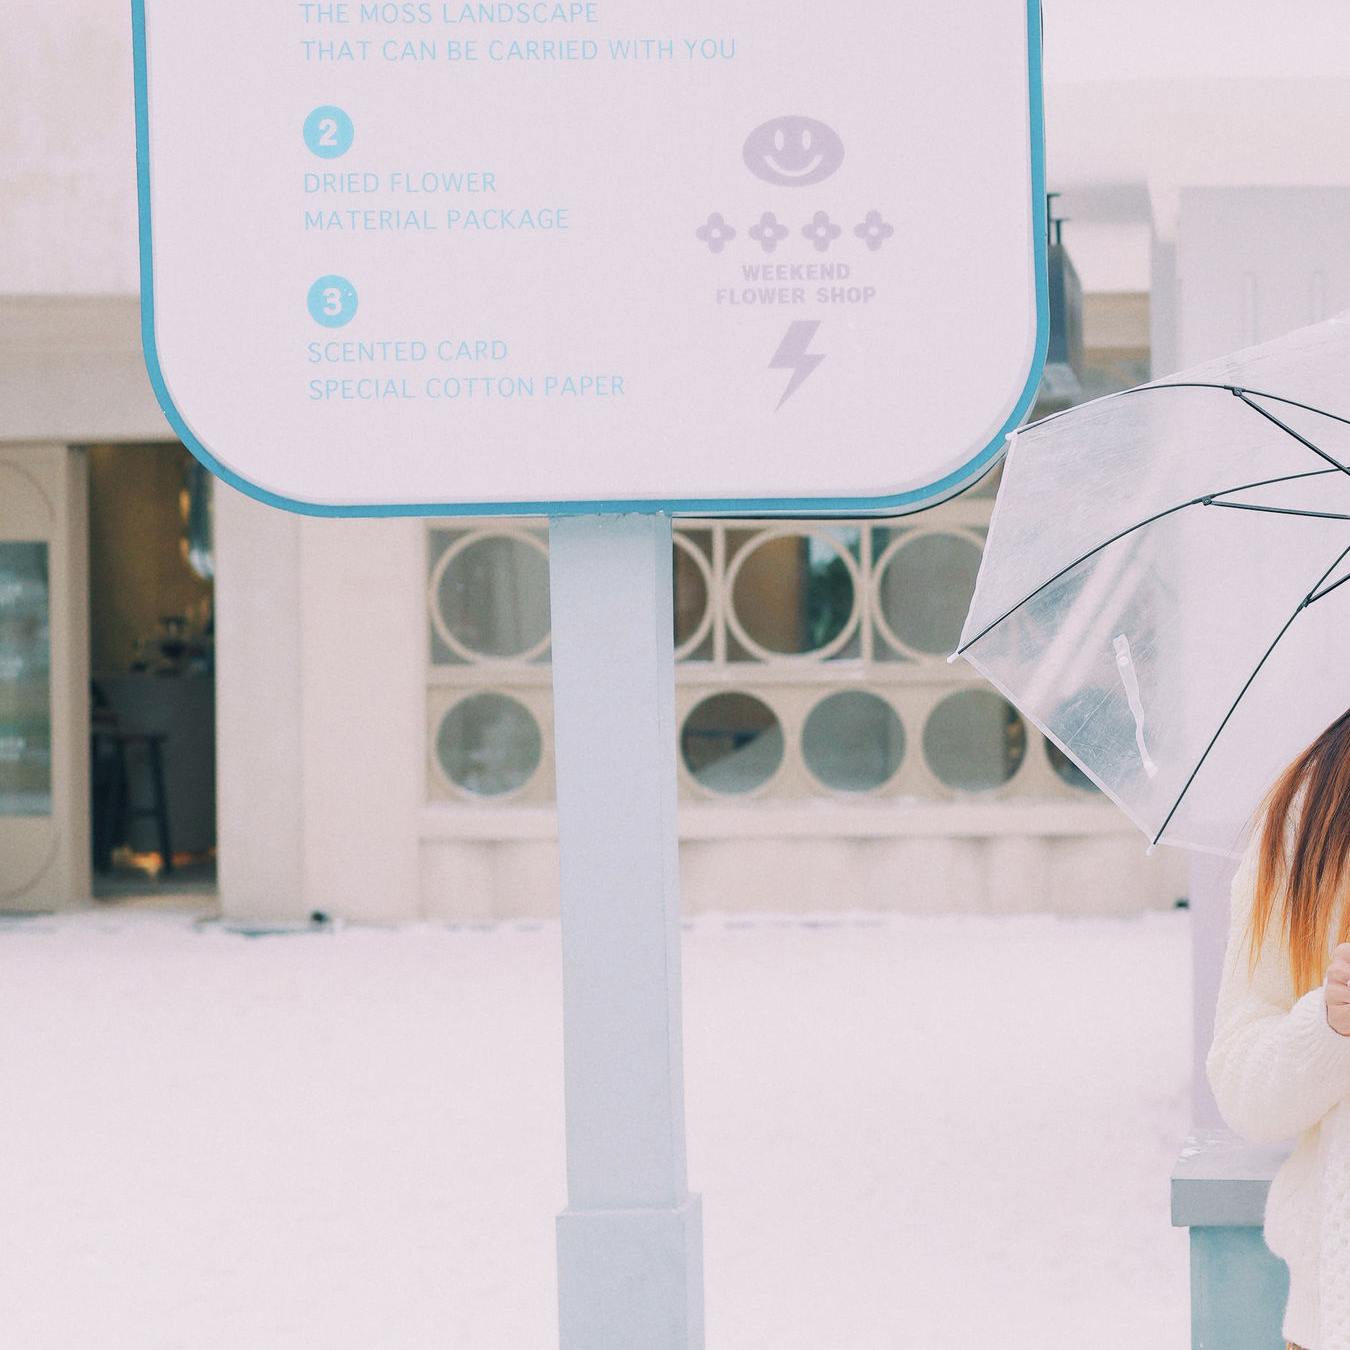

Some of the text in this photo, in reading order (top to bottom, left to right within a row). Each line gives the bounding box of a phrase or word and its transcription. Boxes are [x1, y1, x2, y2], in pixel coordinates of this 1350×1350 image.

[299, 2, 599, 25] THE MOSS LANDSCAPE
[300, 37, 736, 62] THAT CAN BE CARRIED WITH YOU
[303, 171, 497, 194] DRIED FLOWER
[304, 208, 569, 231] MATERIAL PACKAGE
[741, 263, 851, 282] WEEKEND
[716, 286, 877, 306] FLOWER SHOP
[307, 340, 508, 364] SCENTED CARD
[308, 375, 625, 401] SPECIAL COTTON PAPER
